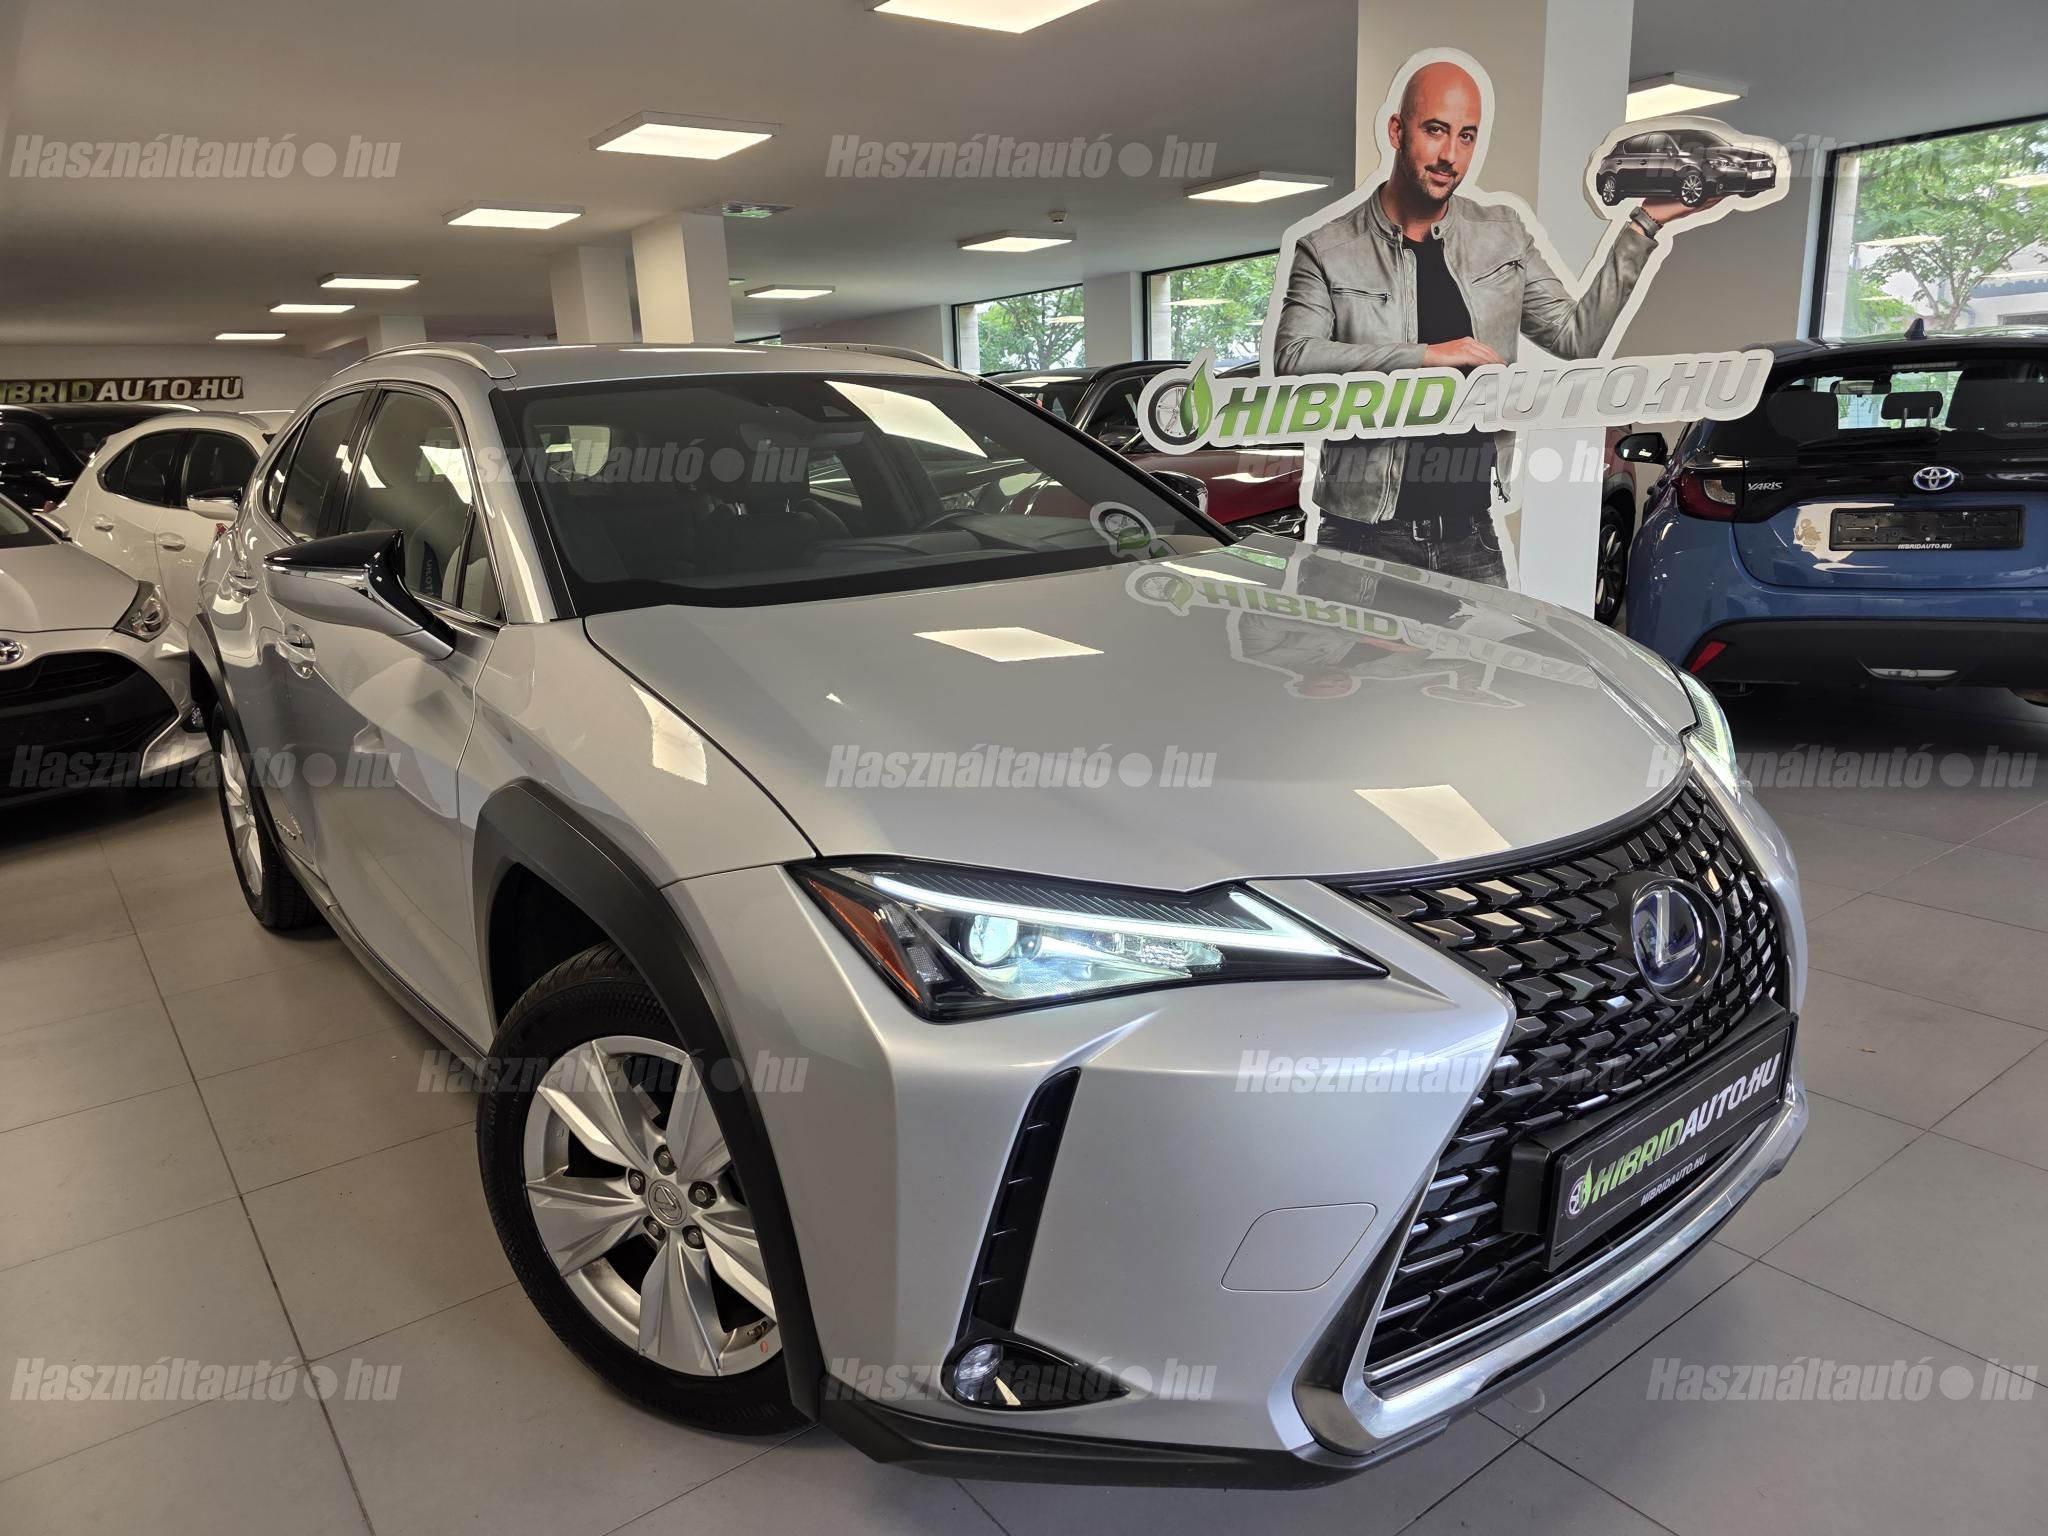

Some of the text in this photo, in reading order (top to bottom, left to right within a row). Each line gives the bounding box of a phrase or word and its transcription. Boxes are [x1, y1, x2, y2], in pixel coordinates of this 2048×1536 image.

[1217, 356, 1763, 438] HIBRIDAUTO.HU
[1748, 481, 1783, 491] YARIS
[1592, 1052, 1782, 1204] HIBRIDAUTO.HU
[1640, 1153, 1708, 1206] HIBRIDAUTO.HU
